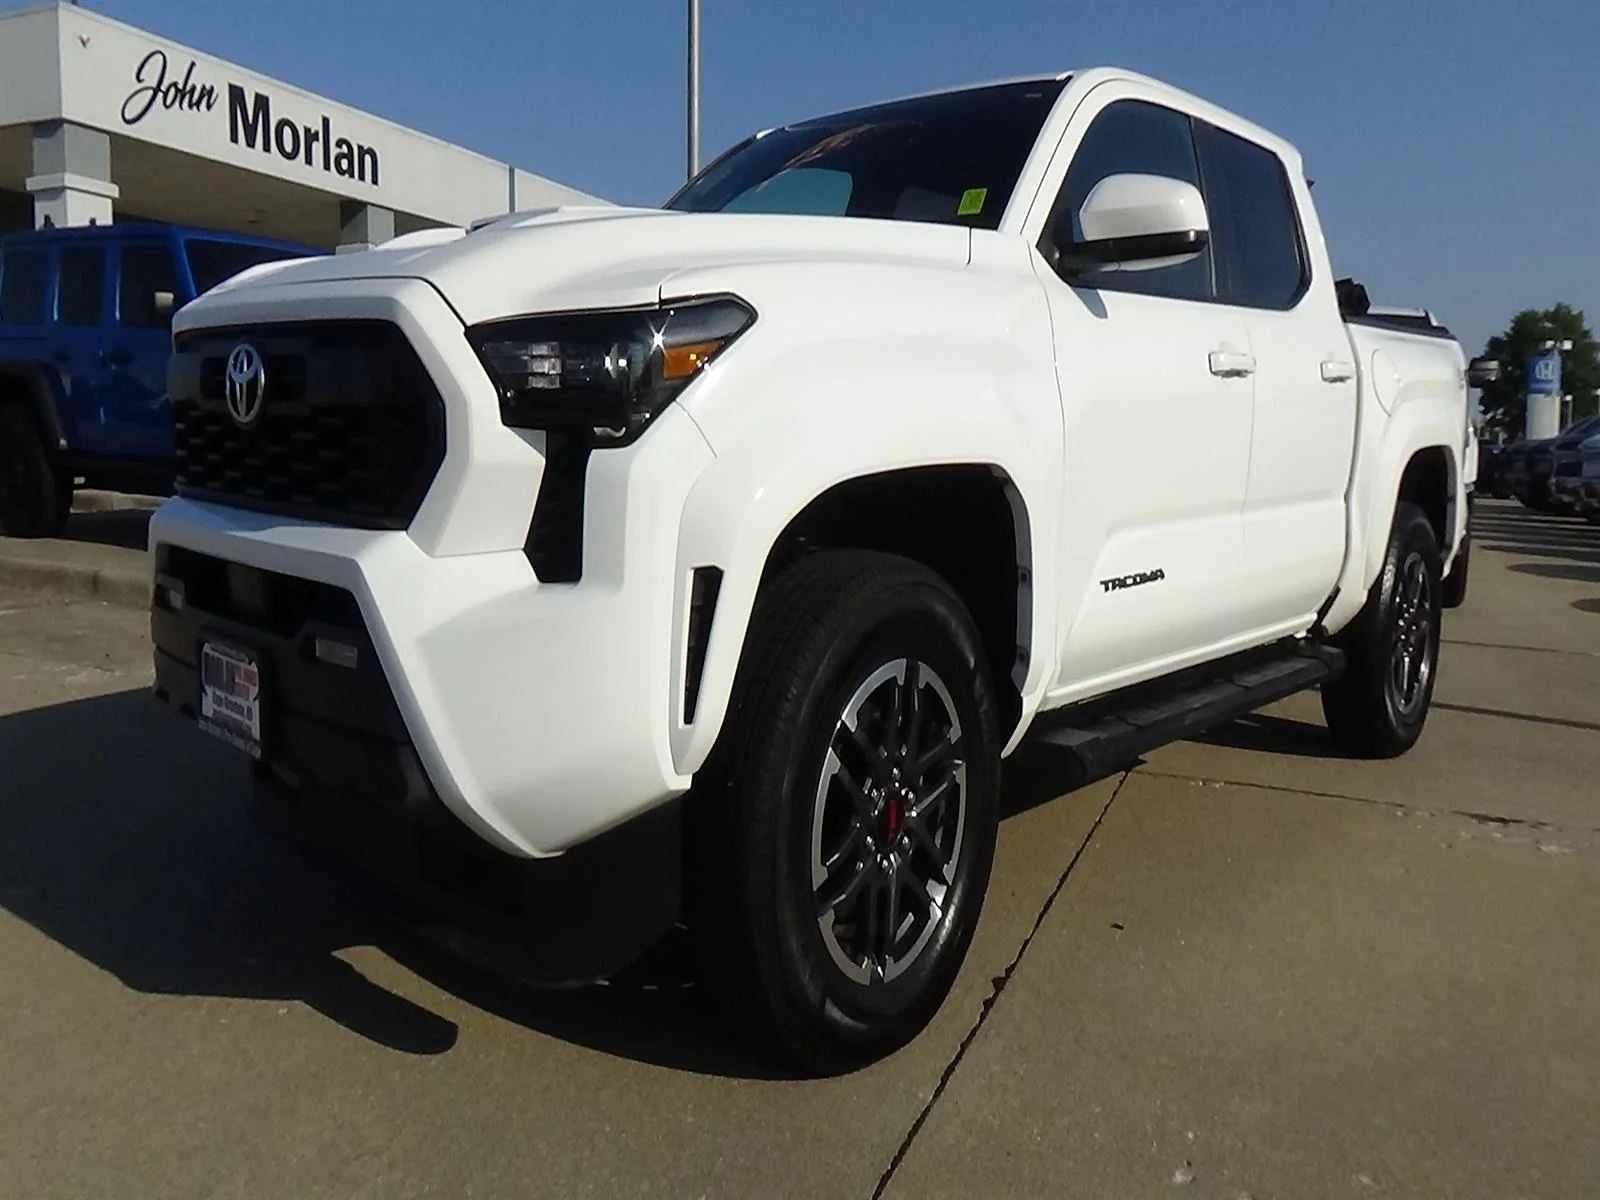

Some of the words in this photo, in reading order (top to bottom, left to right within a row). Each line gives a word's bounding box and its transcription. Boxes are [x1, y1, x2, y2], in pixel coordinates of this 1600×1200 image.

[121, 50, 218, 125] John
[227, 81, 379, 186] Morlan
[1100, 568, 1165, 593] TACOMA
